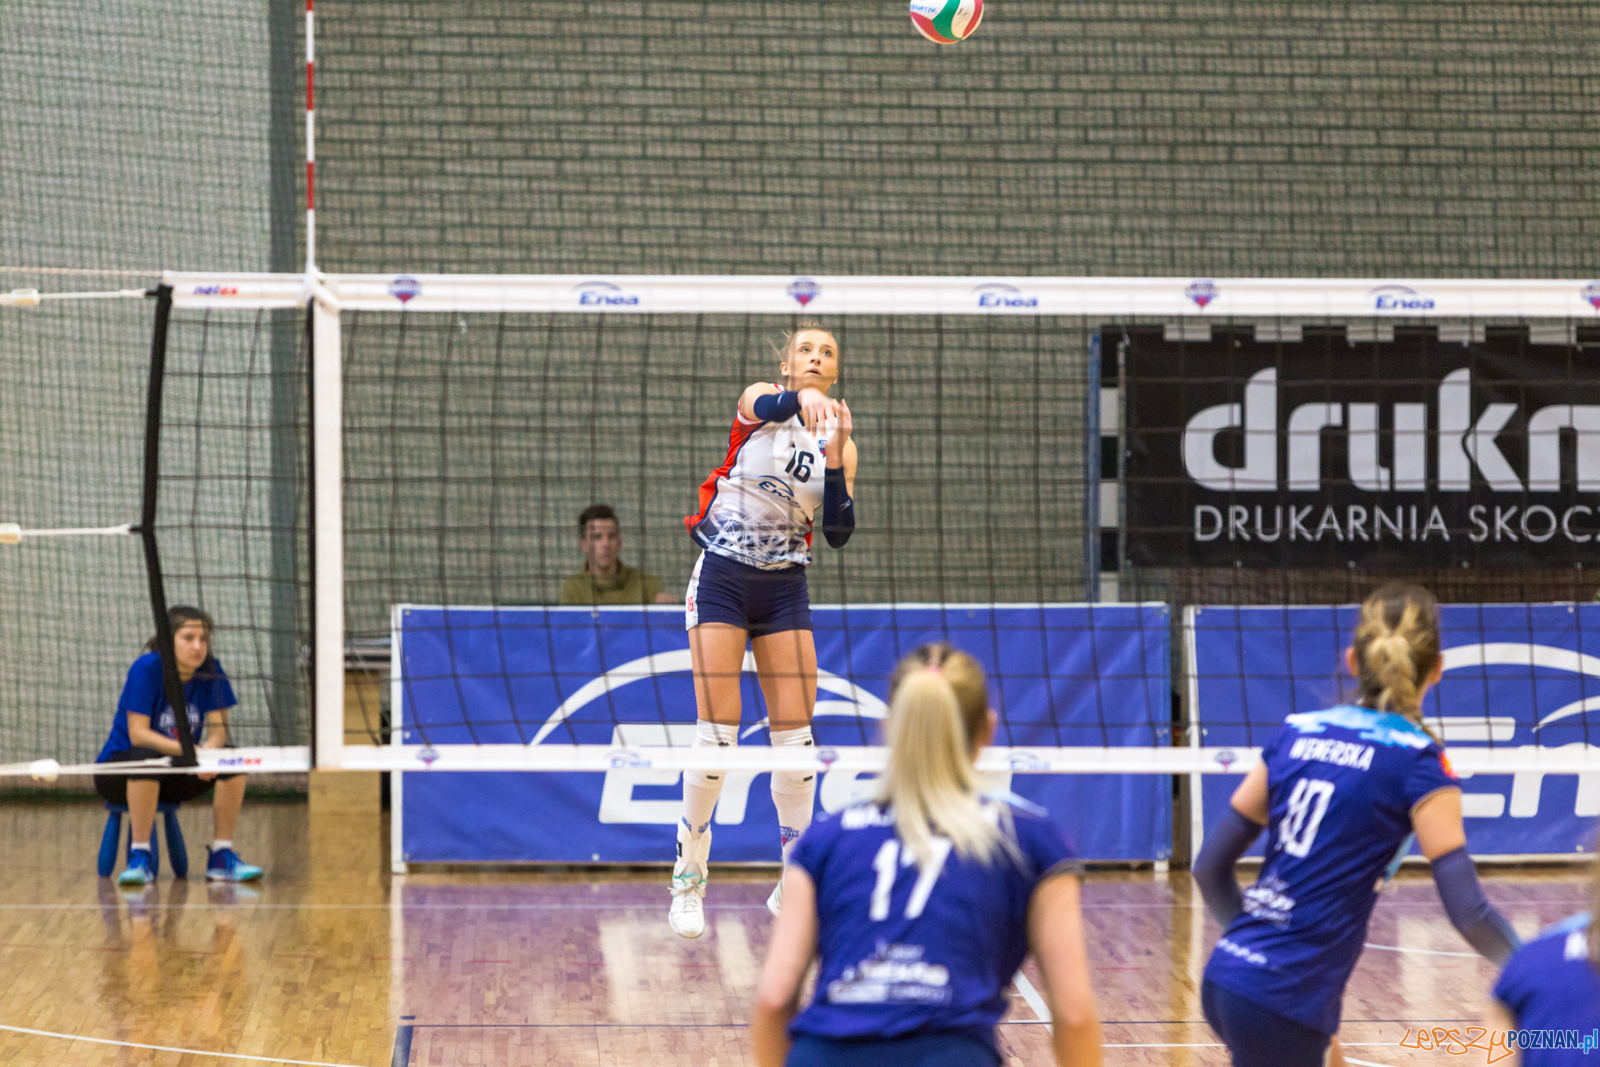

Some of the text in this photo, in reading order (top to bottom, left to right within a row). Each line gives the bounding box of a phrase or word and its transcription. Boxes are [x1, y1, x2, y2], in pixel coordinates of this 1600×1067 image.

[579, 290, 639, 305] Enea
[978, 292, 1038, 307] Enea
[1375, 294, 1435, 309] Enea
[784, 443, 815, 483] 16
[1194, 503, 1600, 544] DRUKARNIA SKOC
[1275, 777, 1335, 858] 10
[869, 839, 951, 921] 17
